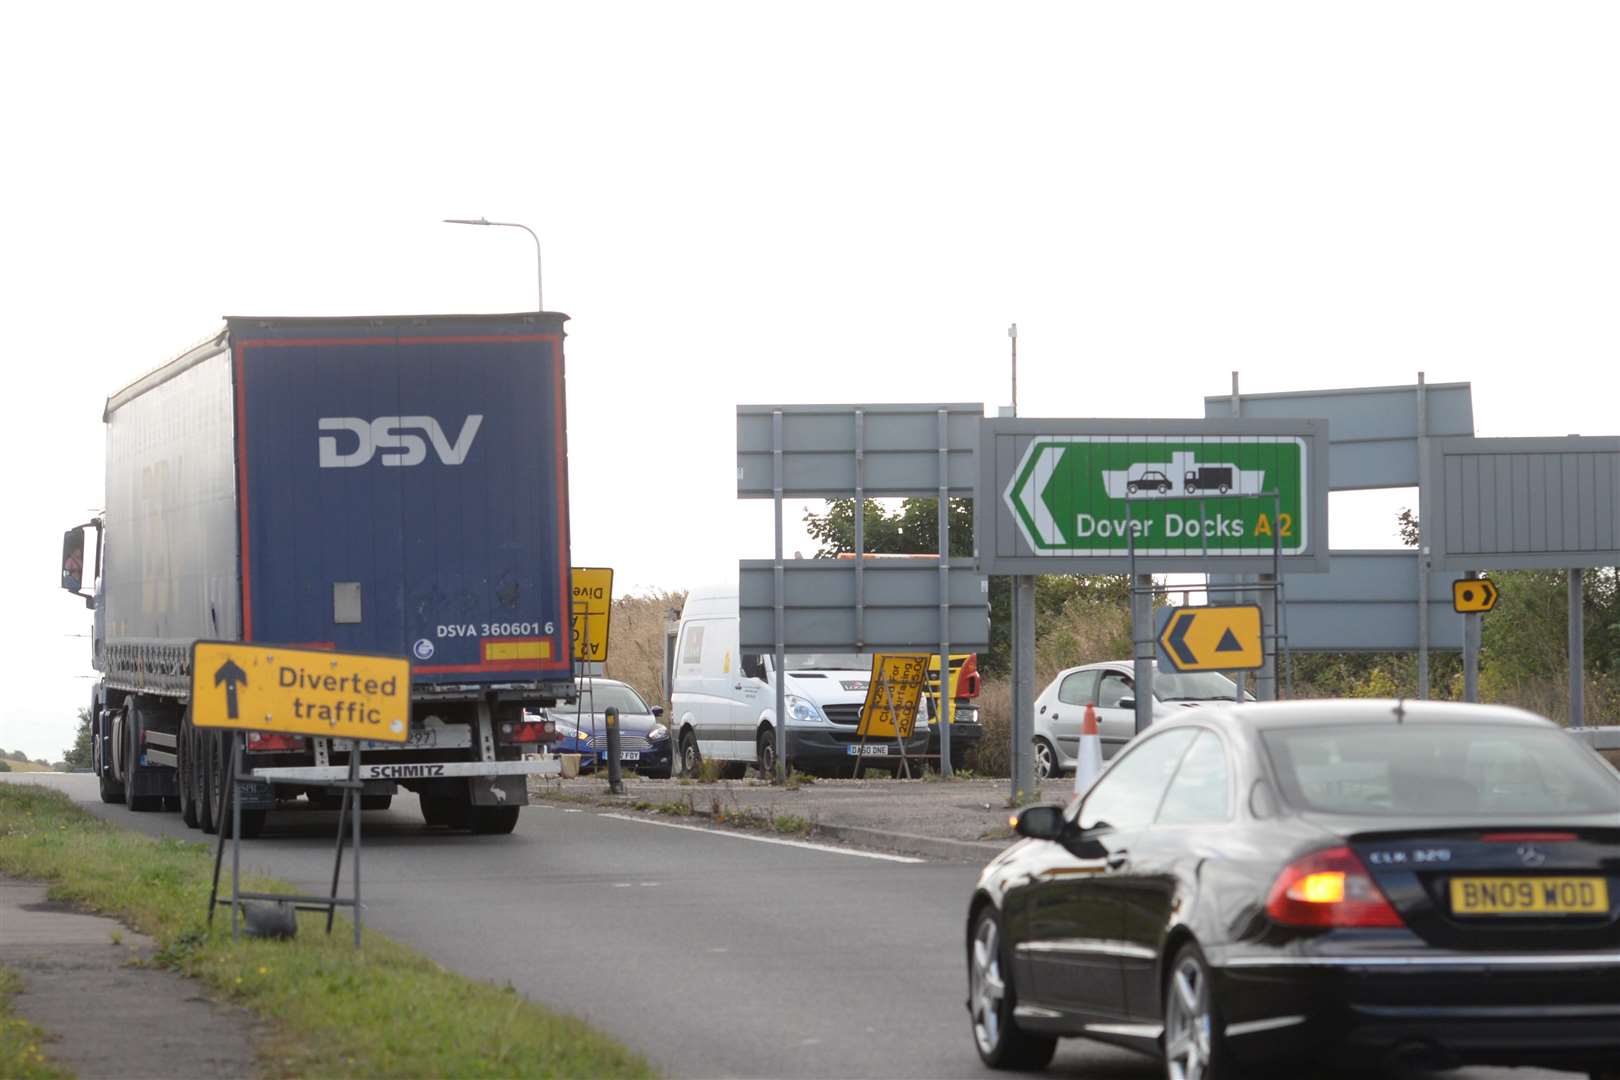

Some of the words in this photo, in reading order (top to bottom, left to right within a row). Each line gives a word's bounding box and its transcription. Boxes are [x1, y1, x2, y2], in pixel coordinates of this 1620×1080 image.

[318, 414, 484, 468] DSV
[1076, 513, 1153, 537] Dover
[1165, 513, 1245, 537] Docks
[437, 624, 477, 637] DSVA
[481, 622, 539, 636] 360601
[544, 622, 554, 635] 6
[279, 666, 397, 696] Diverted
[293, 697, 382, 725] traffic
[370, 764, 445, 778] SCHMITZ
[1463, 883, 1535, 908] BN09
